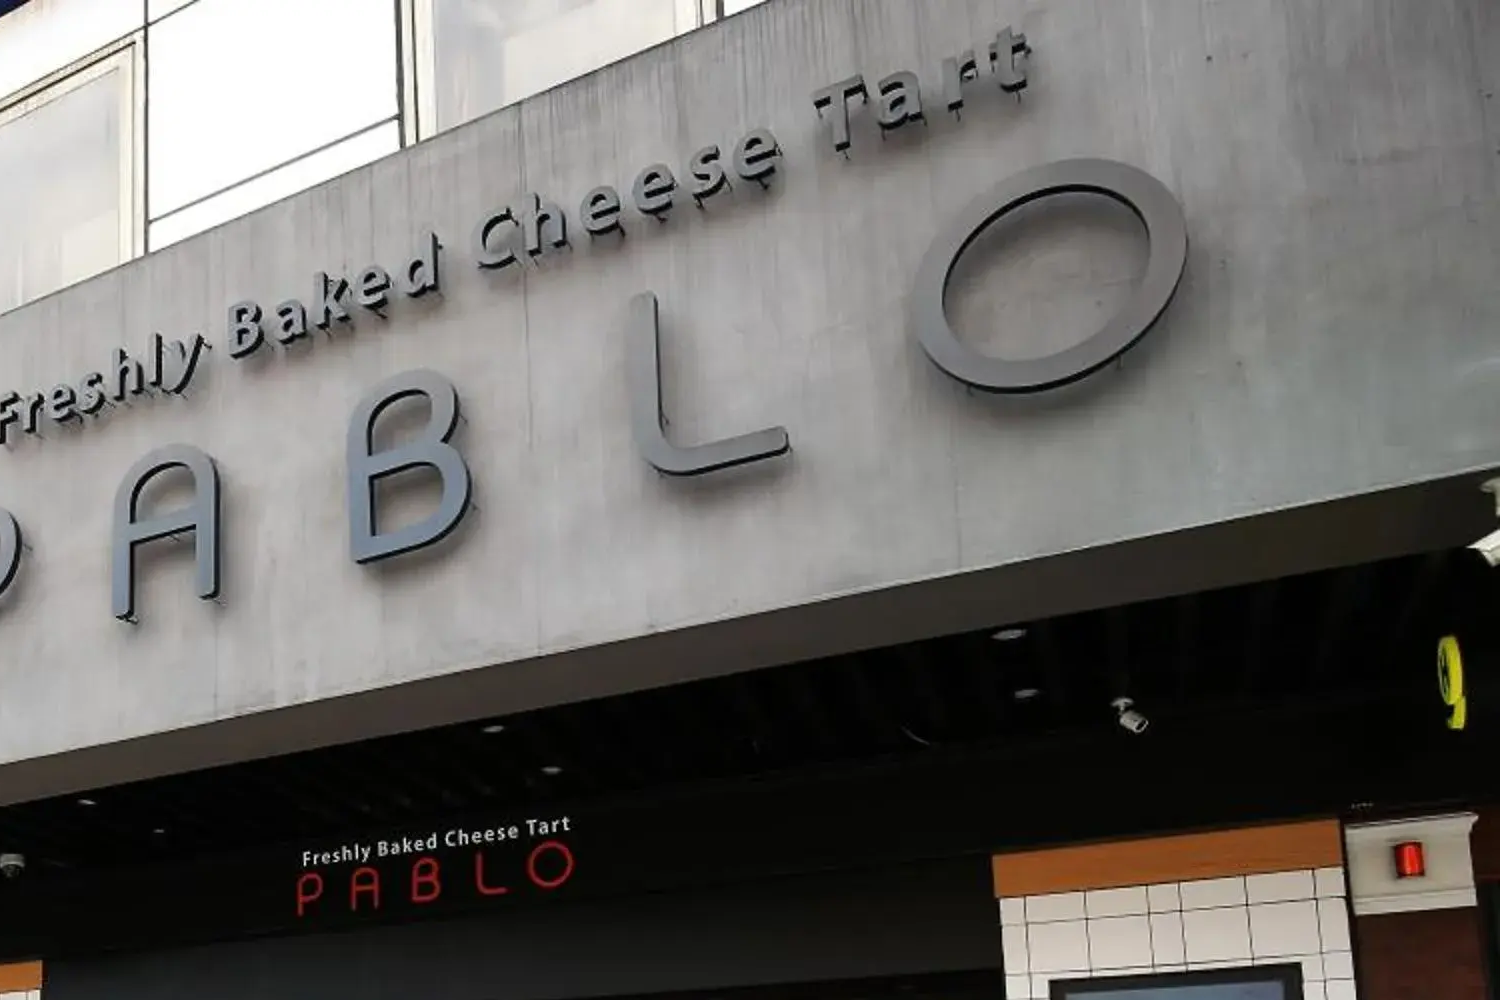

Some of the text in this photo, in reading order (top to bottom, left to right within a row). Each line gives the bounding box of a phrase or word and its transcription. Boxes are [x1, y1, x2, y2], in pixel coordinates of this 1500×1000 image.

[226, 232, 443, 360] Baked
[477, 127, 782, 271] Cheese
[812, 25, 1031, 153] Tart
[297, 841, 574, 917] PABLO
[302, 815, 571, 867] Freshly Baked Cheese Tart
